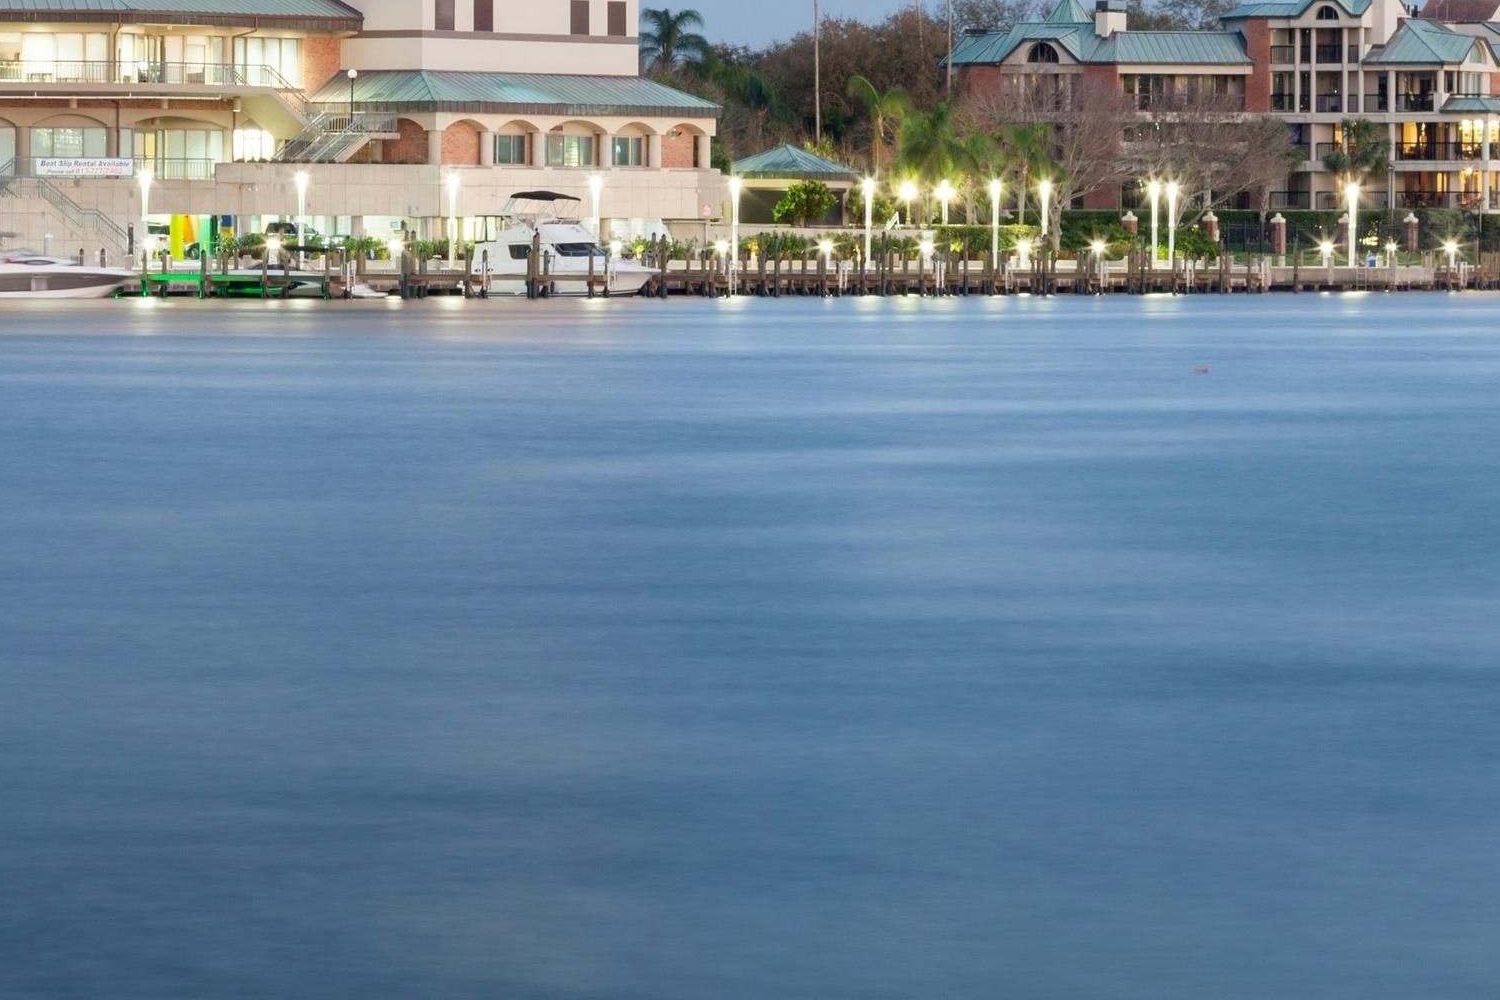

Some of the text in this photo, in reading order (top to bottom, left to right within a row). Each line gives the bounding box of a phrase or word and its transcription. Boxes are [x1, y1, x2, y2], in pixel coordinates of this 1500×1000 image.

[40, 160, 130, 169] Boat Slip Rental Available
